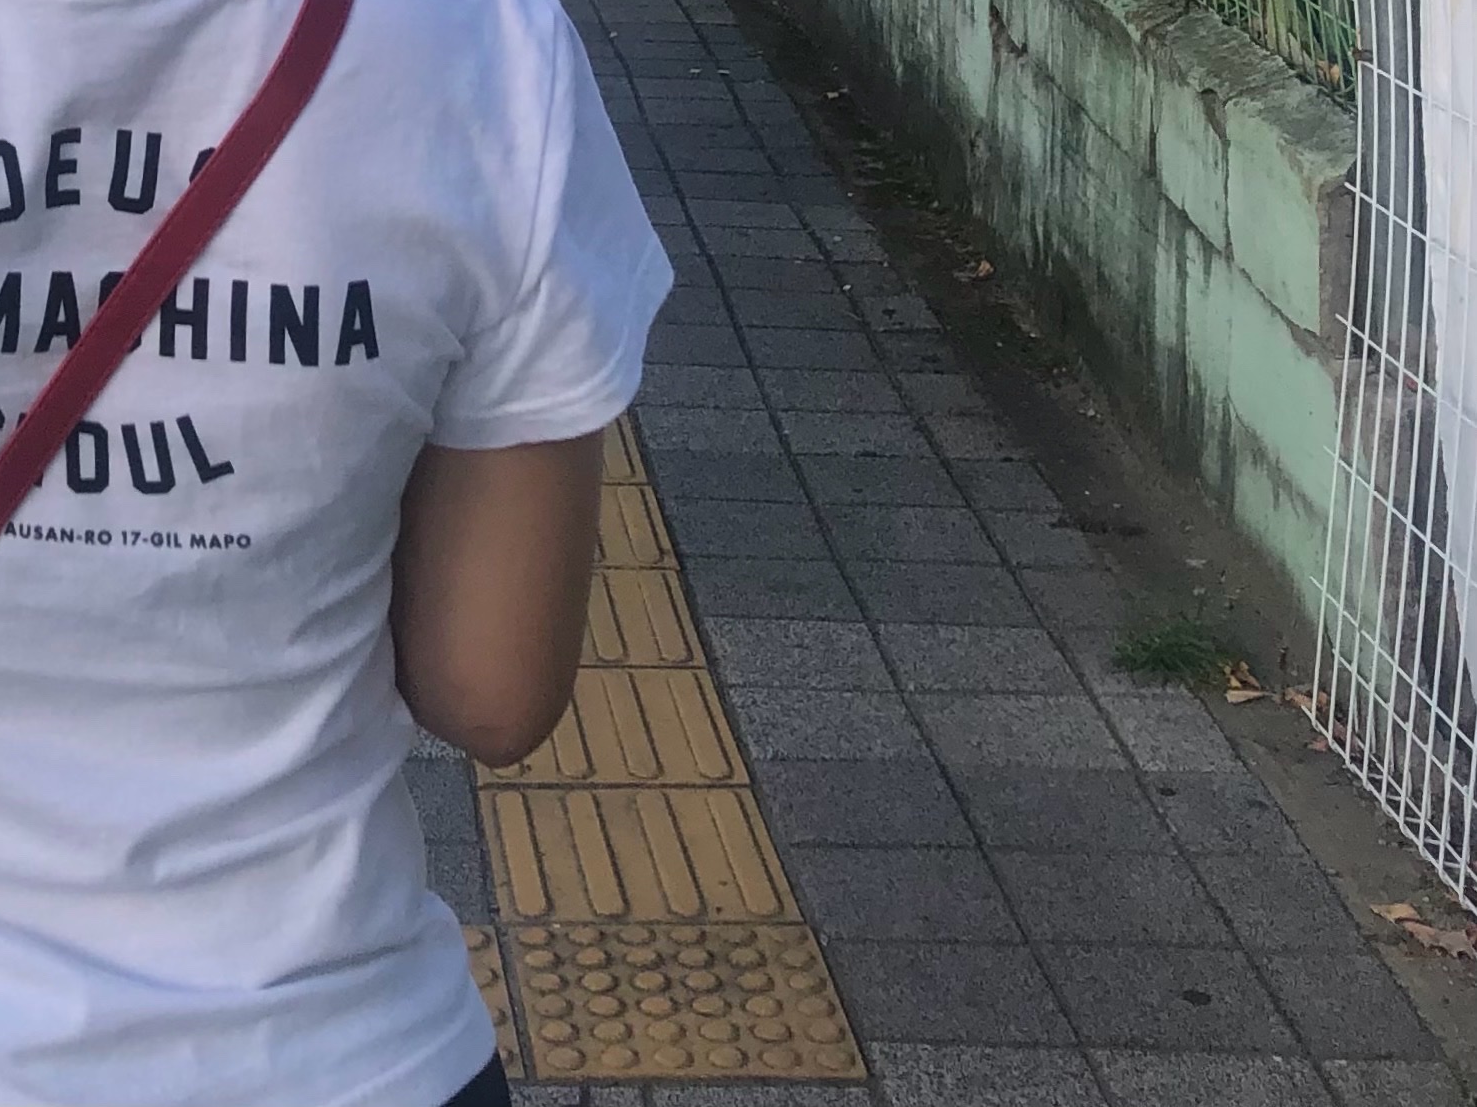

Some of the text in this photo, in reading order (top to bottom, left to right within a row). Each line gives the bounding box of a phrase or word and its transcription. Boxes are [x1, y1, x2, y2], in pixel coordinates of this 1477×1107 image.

[4, 521, 113, 546] AUSAN-RO
[121, 529, 183, 550] 17-GIL
[190, 533, 252, 551] MAPO
